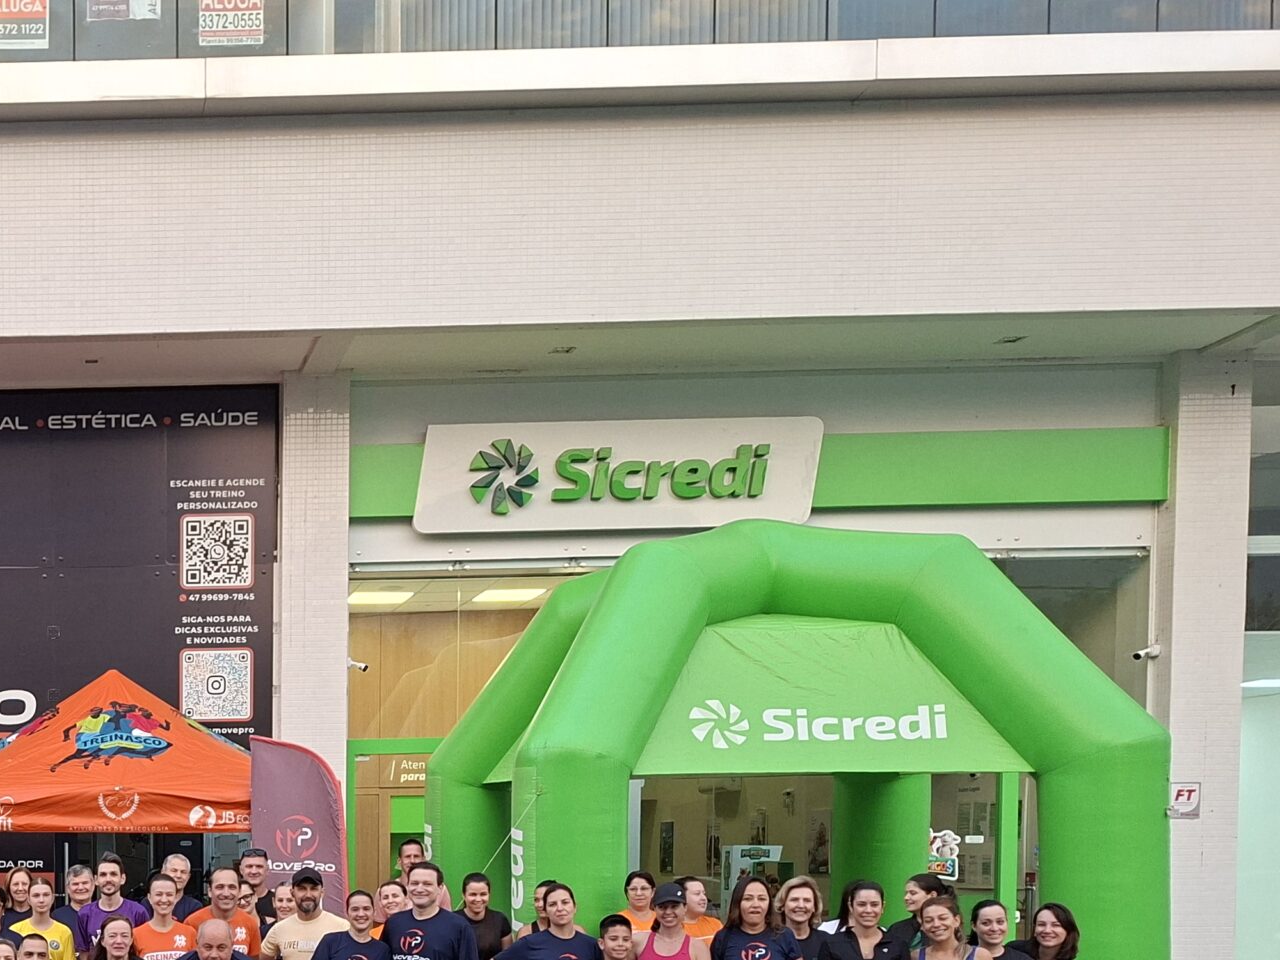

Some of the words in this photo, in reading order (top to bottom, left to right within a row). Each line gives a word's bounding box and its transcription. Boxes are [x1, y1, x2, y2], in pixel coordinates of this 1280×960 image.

[200, 13, 261, 29] 3372-0555
[21, 23, 44, 34] 1122
[47, 411, 157, 430] ESTÉTICA
[180, 408, 259, 427] SAÚDE
[551, 443, 772, 502] Sicredi
[169, 479, 217, 488] ESCANEIE
[218, 479, 224, 487] E
[225, 478, 266, 486] AGENDE
[189, 490, 208, 499] SEU
[209, 489, 246, 498] TREINO
[176, 500, 259, 510] PERSONALIZADO
[188, 594, 200, 602] 47
[201, 593, 255, 601] 99699-7845
[181, 616, 226, 624] SIGA-NOS
[226, 615, 252, 623] PARA
[174, 627, 203, 635] DICAS
[203, 625, 259, 634] EXCLUSIVAS
[186, 637, 193, 645] E
[193, 636, 247, 644] NOVIDADES
[761, 703, 948, 742] Sicredi
[82, 733, 163, 748] TREINASCO
[400, 773, 426, 783] para
[1174, 788, 1197, 802] FT
[217, 811, 236, 824] JB
[17, 860, 44, 868] DOR
[283, 940, 299, 950] LIVE!
